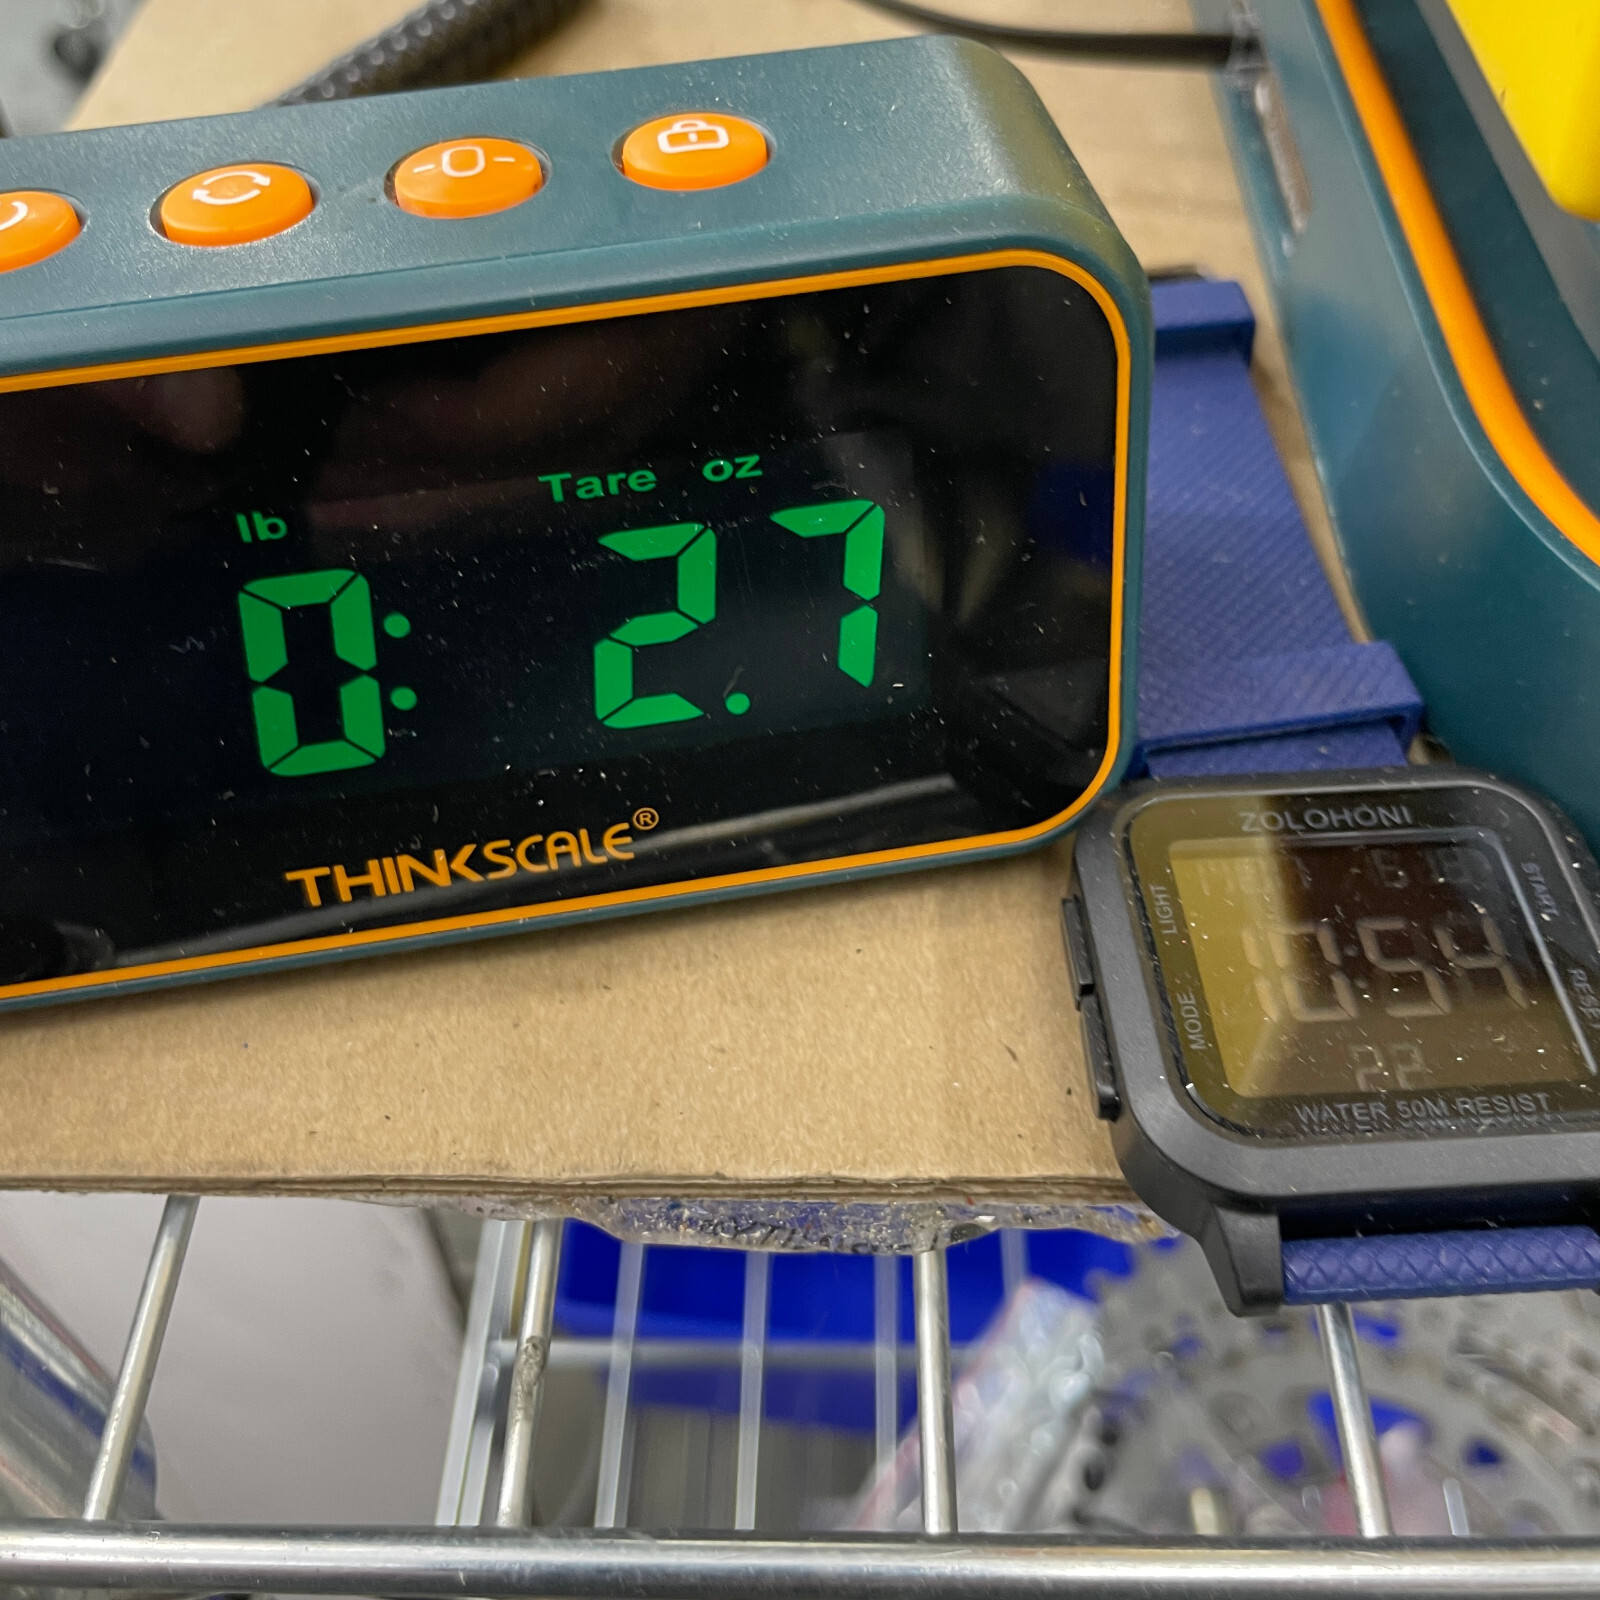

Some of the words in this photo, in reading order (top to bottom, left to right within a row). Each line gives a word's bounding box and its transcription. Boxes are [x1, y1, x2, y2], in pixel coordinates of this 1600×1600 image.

[539, 471, 656, 501] Tare
[703, 455, 762, 481] oz
[237, 513, 286, 541] lb
[594, 499, 886, 729] 2.7
[1240, 805, 1412, 832] ZOLOHONI
[1150, 884, 1178, 934] LIGHT
[1521, 862, 1560, 917] START
[1176, 989, 1207, 1050] MODE
[1294, 1102, 1391, 1126] WATER
[1396, 1096, 1450, 1120] 50M
[1455, 1092, 1550, 1117] RESIST
